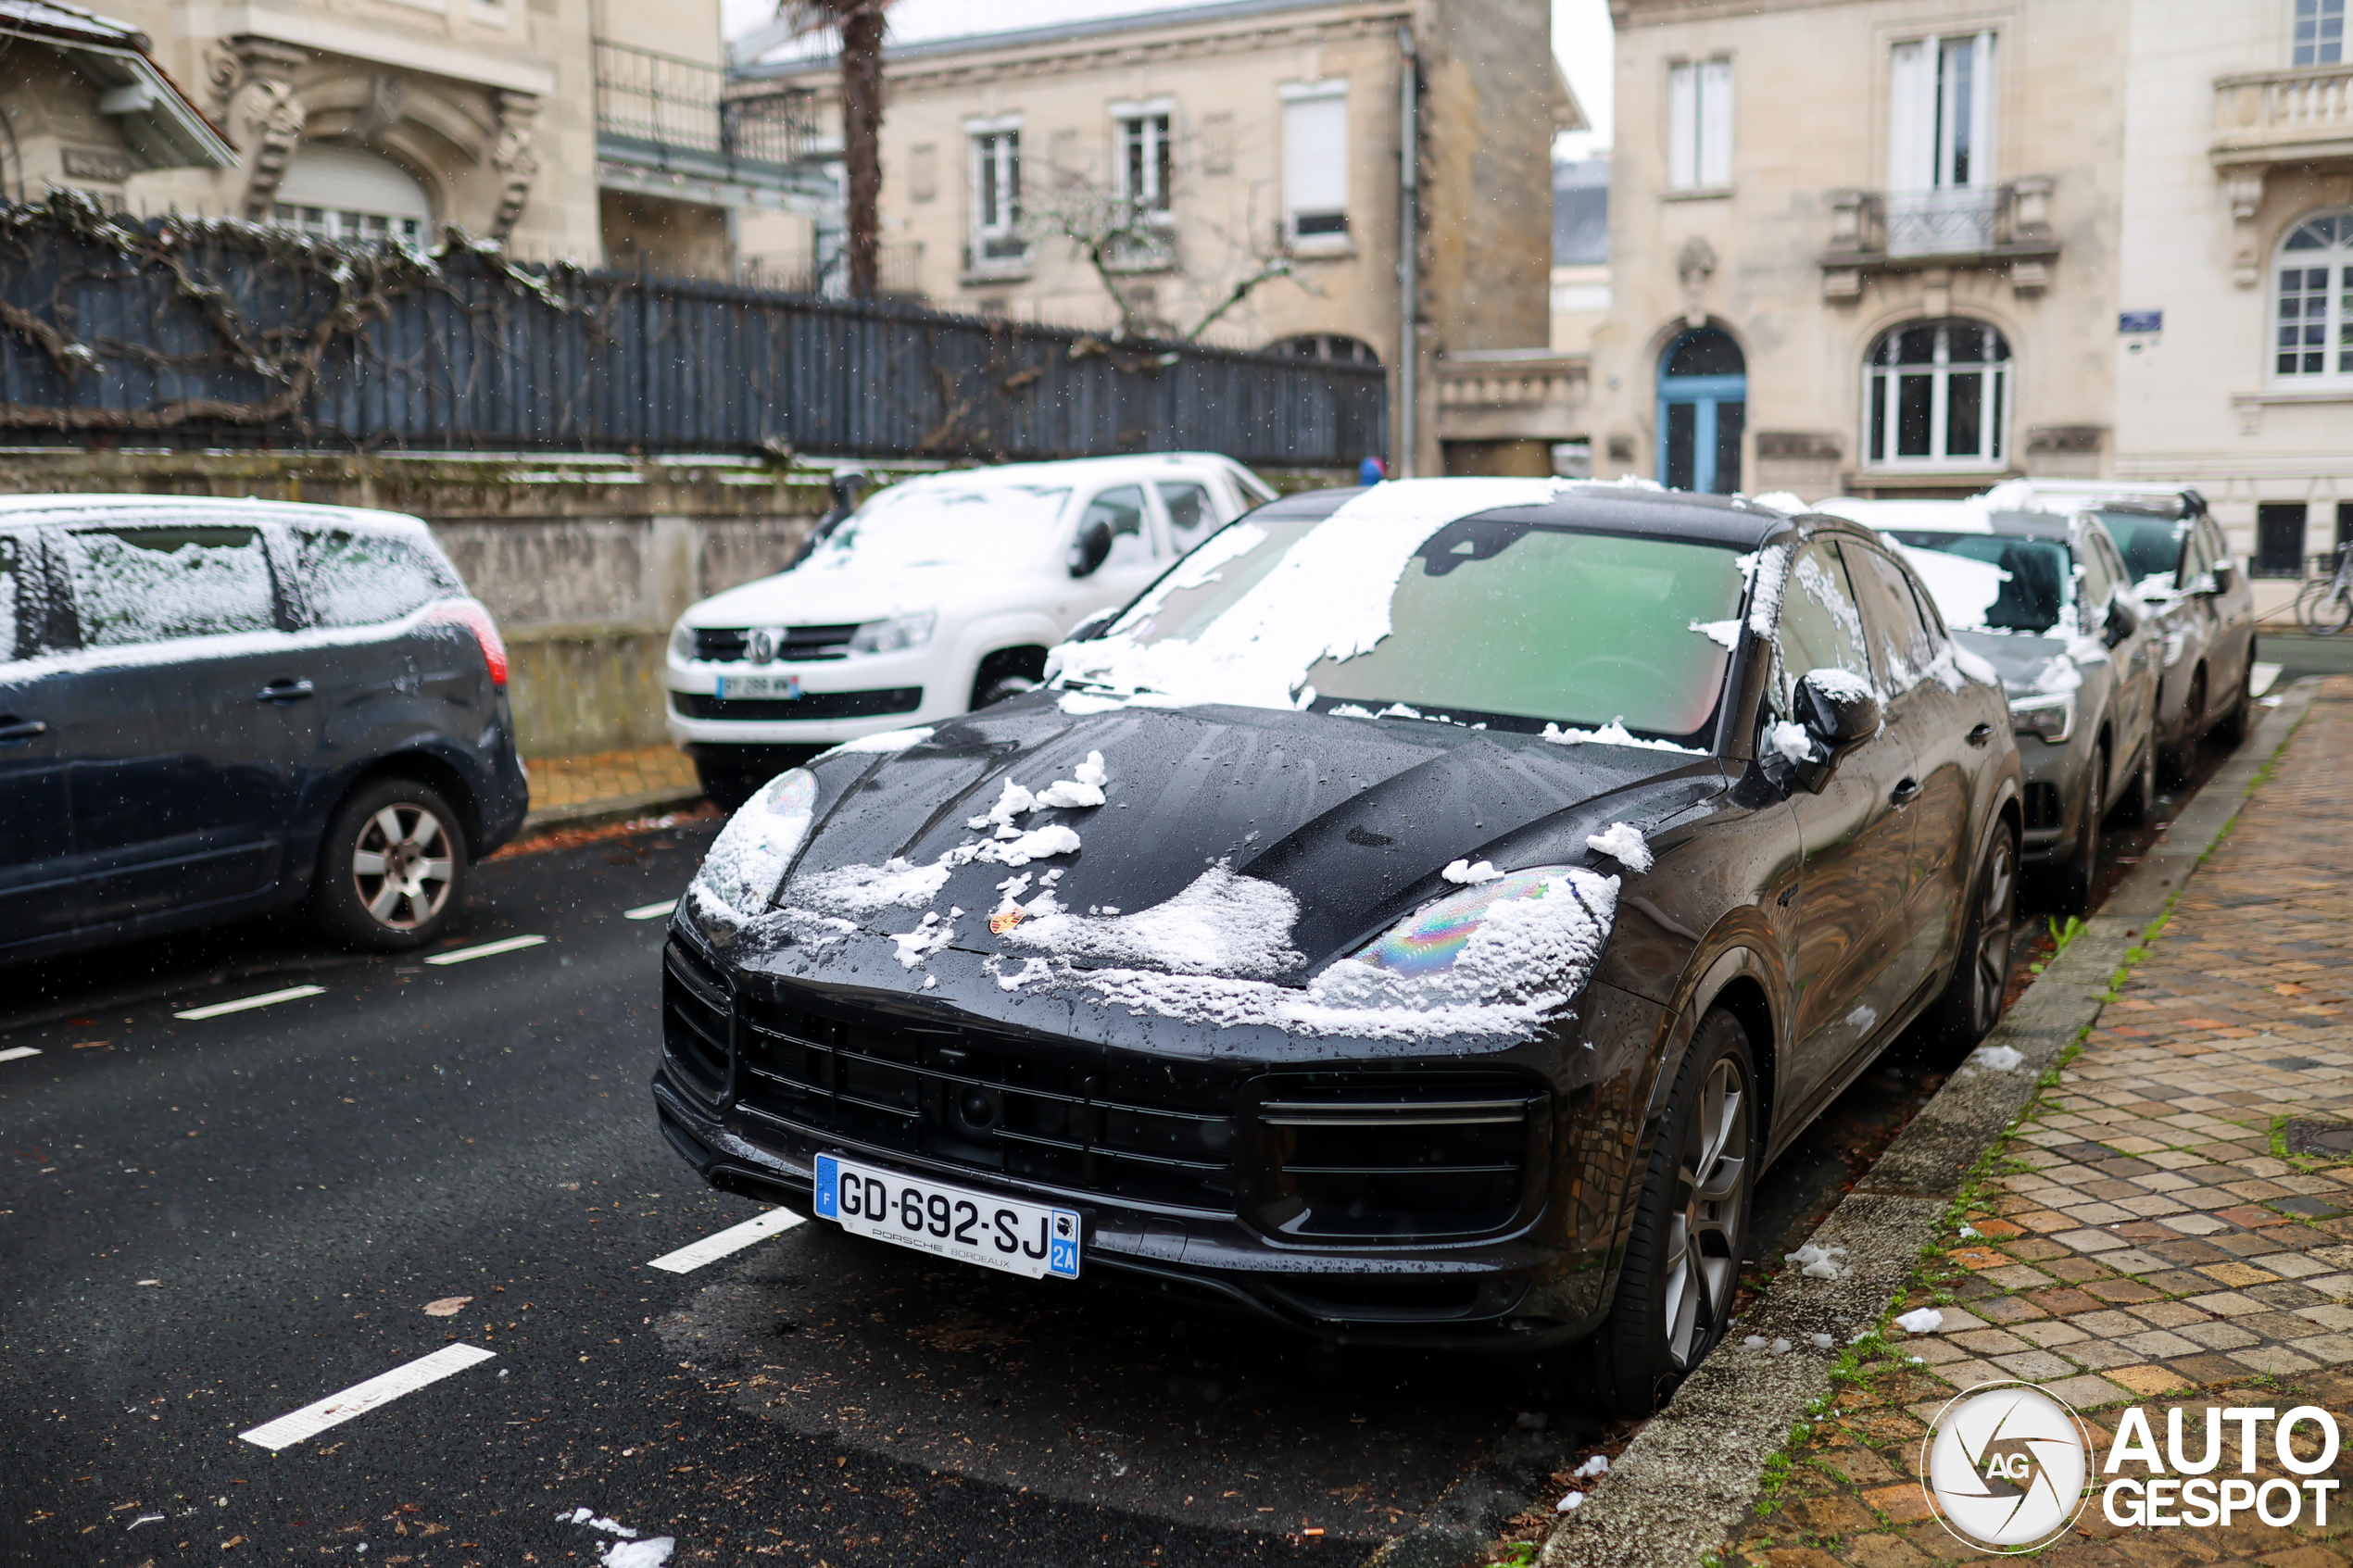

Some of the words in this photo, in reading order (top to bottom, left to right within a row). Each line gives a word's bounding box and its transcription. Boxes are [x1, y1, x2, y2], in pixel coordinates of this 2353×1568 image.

[823, 1192, 830, 1205] F
[839, 1172, 1049, 1260] GD-692-SJ
[872, 1228, 943, 1253] PORSCHE
[950, 1248, 1011, 1269] BORDEAUX
[1052, 1245, 1075, 1270] 2A
